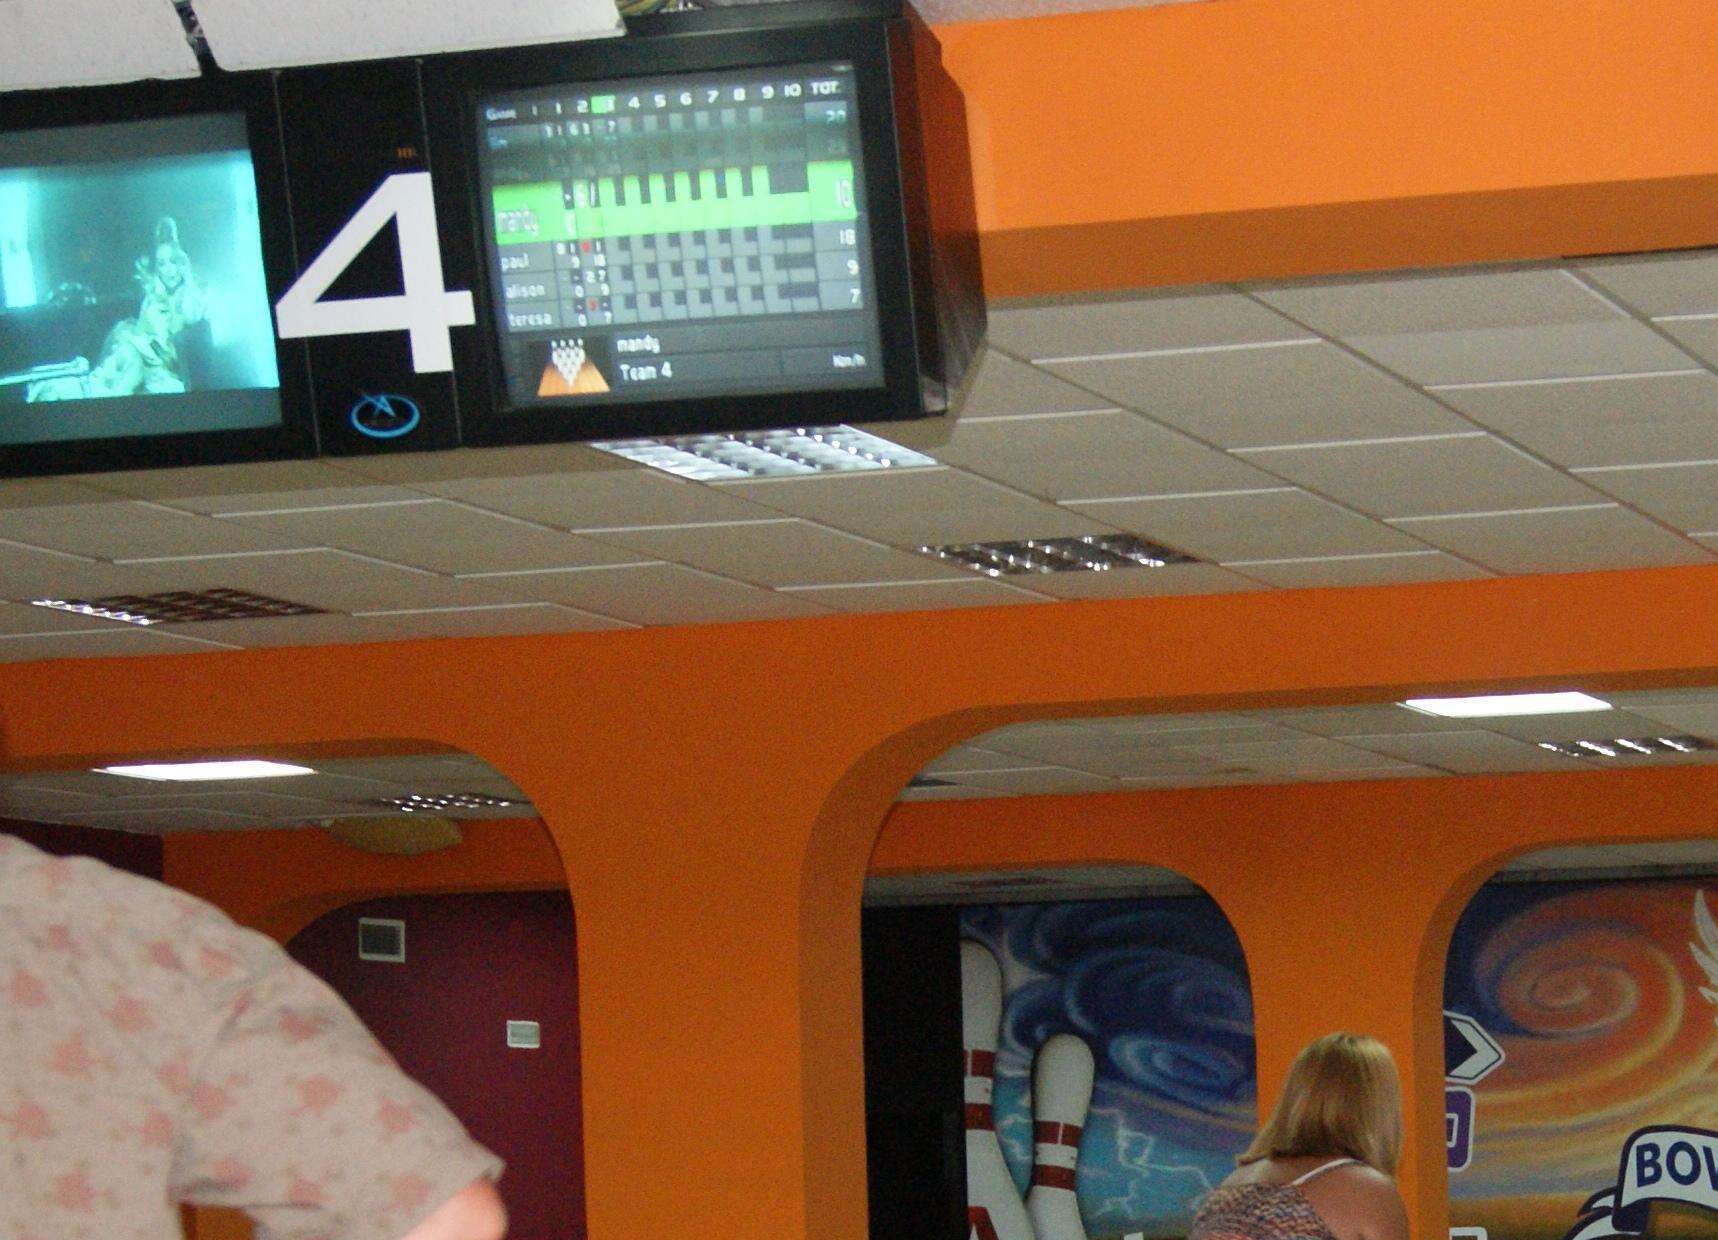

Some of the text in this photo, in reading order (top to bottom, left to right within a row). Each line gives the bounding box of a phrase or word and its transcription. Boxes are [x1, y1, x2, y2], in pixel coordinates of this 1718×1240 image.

[576, 99, 588, 114] 2
[628, 96, 641, 109] 4
[654, 93, 666, 108] 5
[680, 91, 692, 106] 6
[707, 89, 719, 104] 7
[733, 87, 746, 101] 8
[761, 85, 774, 99] 9
[784, 83, 802, 97] 10
[501, 253, 529, 271] paul
[276, 172, 475, 374] 4
[508, 312, 553, 327] teresa
[617, 334, 660, 354] mandy
[620, 362, 657, 381] Team
[661, 360, 672, 378] 4
